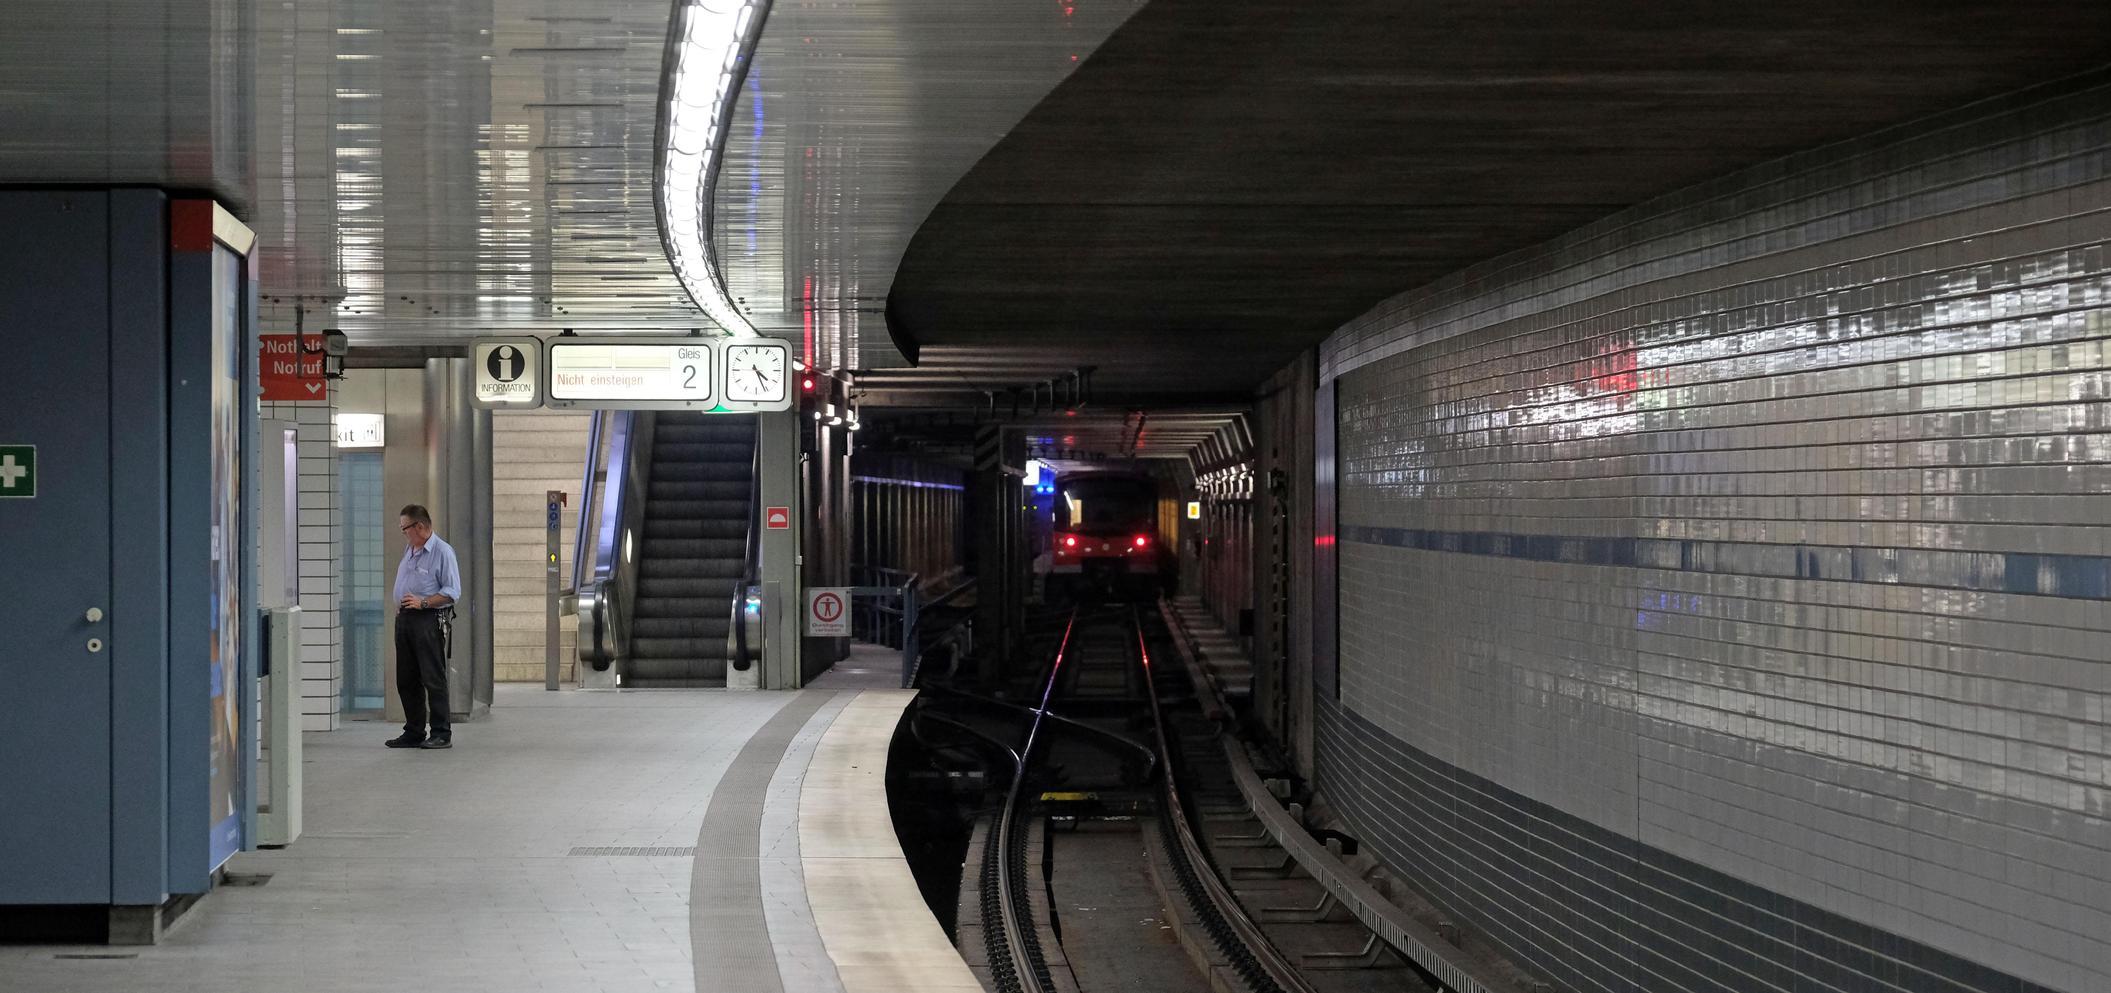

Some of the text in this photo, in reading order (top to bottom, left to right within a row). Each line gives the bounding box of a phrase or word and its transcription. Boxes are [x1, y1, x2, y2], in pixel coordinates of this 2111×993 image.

[678, 348, 701, 359] Gleis
[557, 374, 644, 388] Nicht einsteigen
[683, 365, 697, 389] 2
[481, 383, 531, 392] INFORMATION
